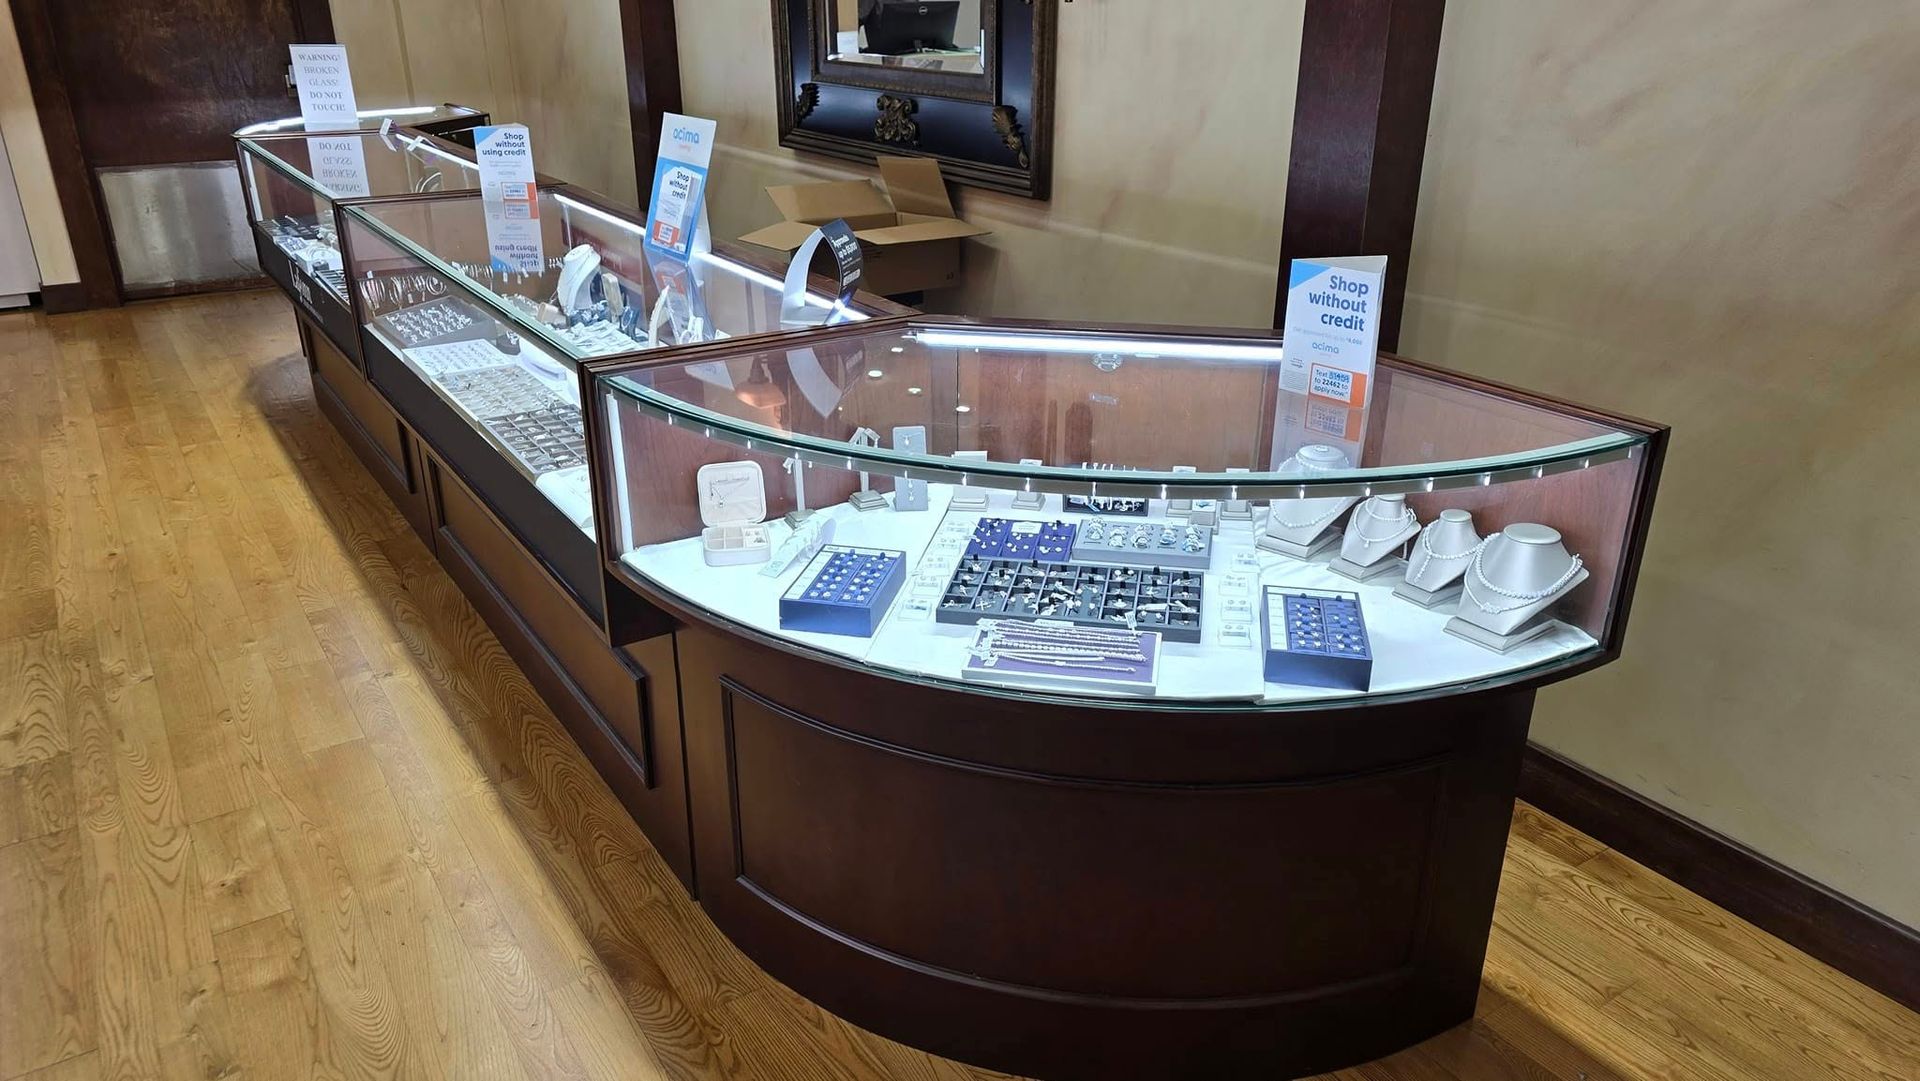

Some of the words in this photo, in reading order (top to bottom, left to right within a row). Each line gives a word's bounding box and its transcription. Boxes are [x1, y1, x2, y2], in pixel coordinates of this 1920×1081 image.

[298, 54, 340, 62] WARNING!
[304, 66, 339, 74] BROKEN
[310, 91, 322, 99] DO
[324, 91, 343, 99] NOT
[312, 104, 346, 112] TOUCH!
[504, 132, 524, 141] Shop
[673, 128, 700, 144] acima
[482, 149, 503, 157] using
[677, 171, 690, 182] Shop
[669, 180, 688, 191] without
[672, 190, 686, 200] credit
[1330, 275, 1369, 298] Shop
[1309, 291, 1367, 313] without
[1321, 313, 1365, 332] credit
[1312, 342, 1339, 354] acima
[1315, 369, 1328, 378] Text
[1322, 378, 1341, 388] 22462
[1314, 385, 1330, 394] apply
